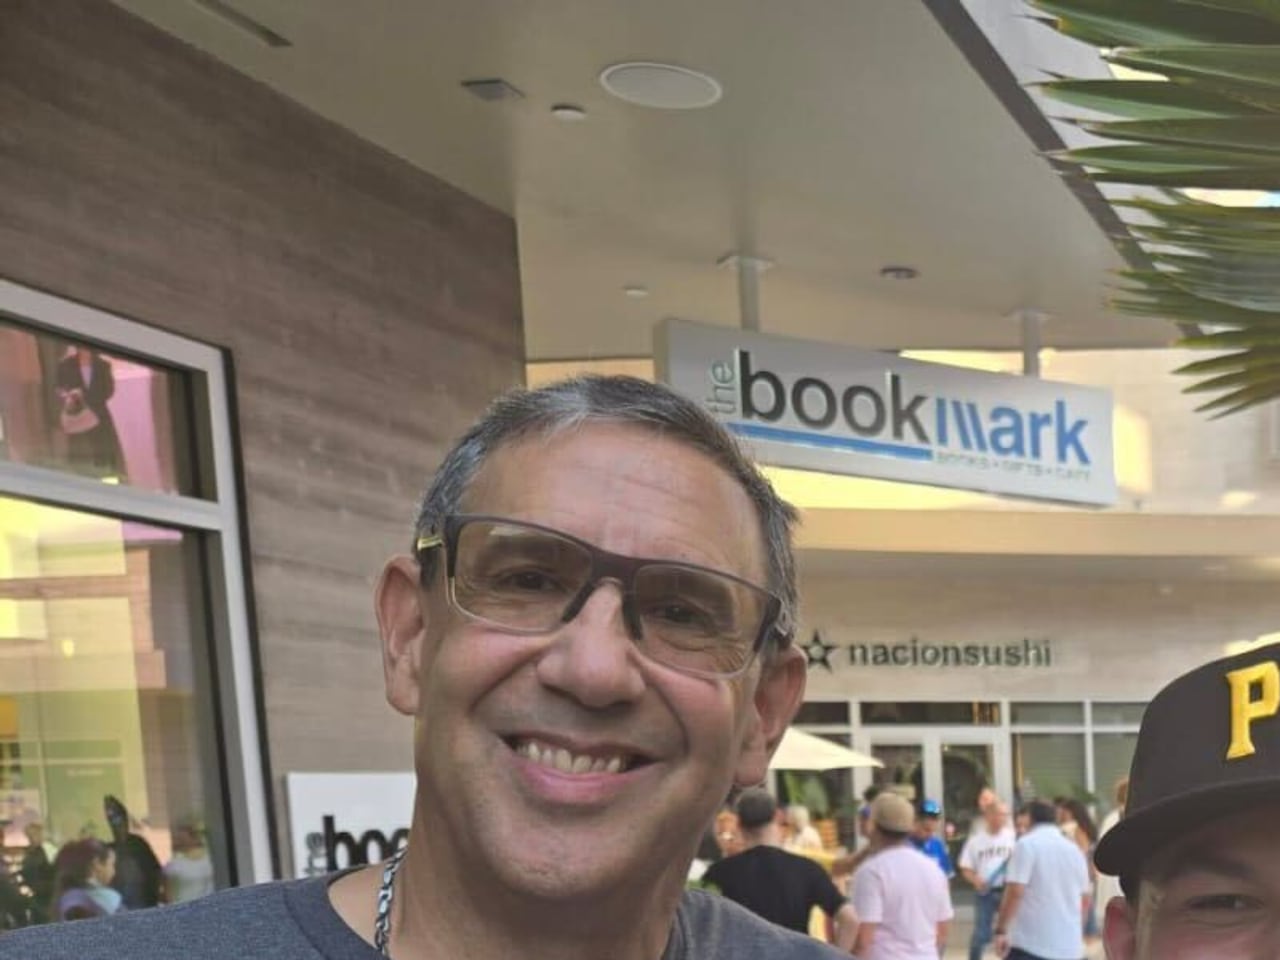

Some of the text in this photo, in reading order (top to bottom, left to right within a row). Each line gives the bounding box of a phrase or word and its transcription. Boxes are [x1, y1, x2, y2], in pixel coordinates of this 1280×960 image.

[706, 362, 735, 414] the
[849, 637, 1053, 667] nacionsushi
[304, 831, 326, 877] he
